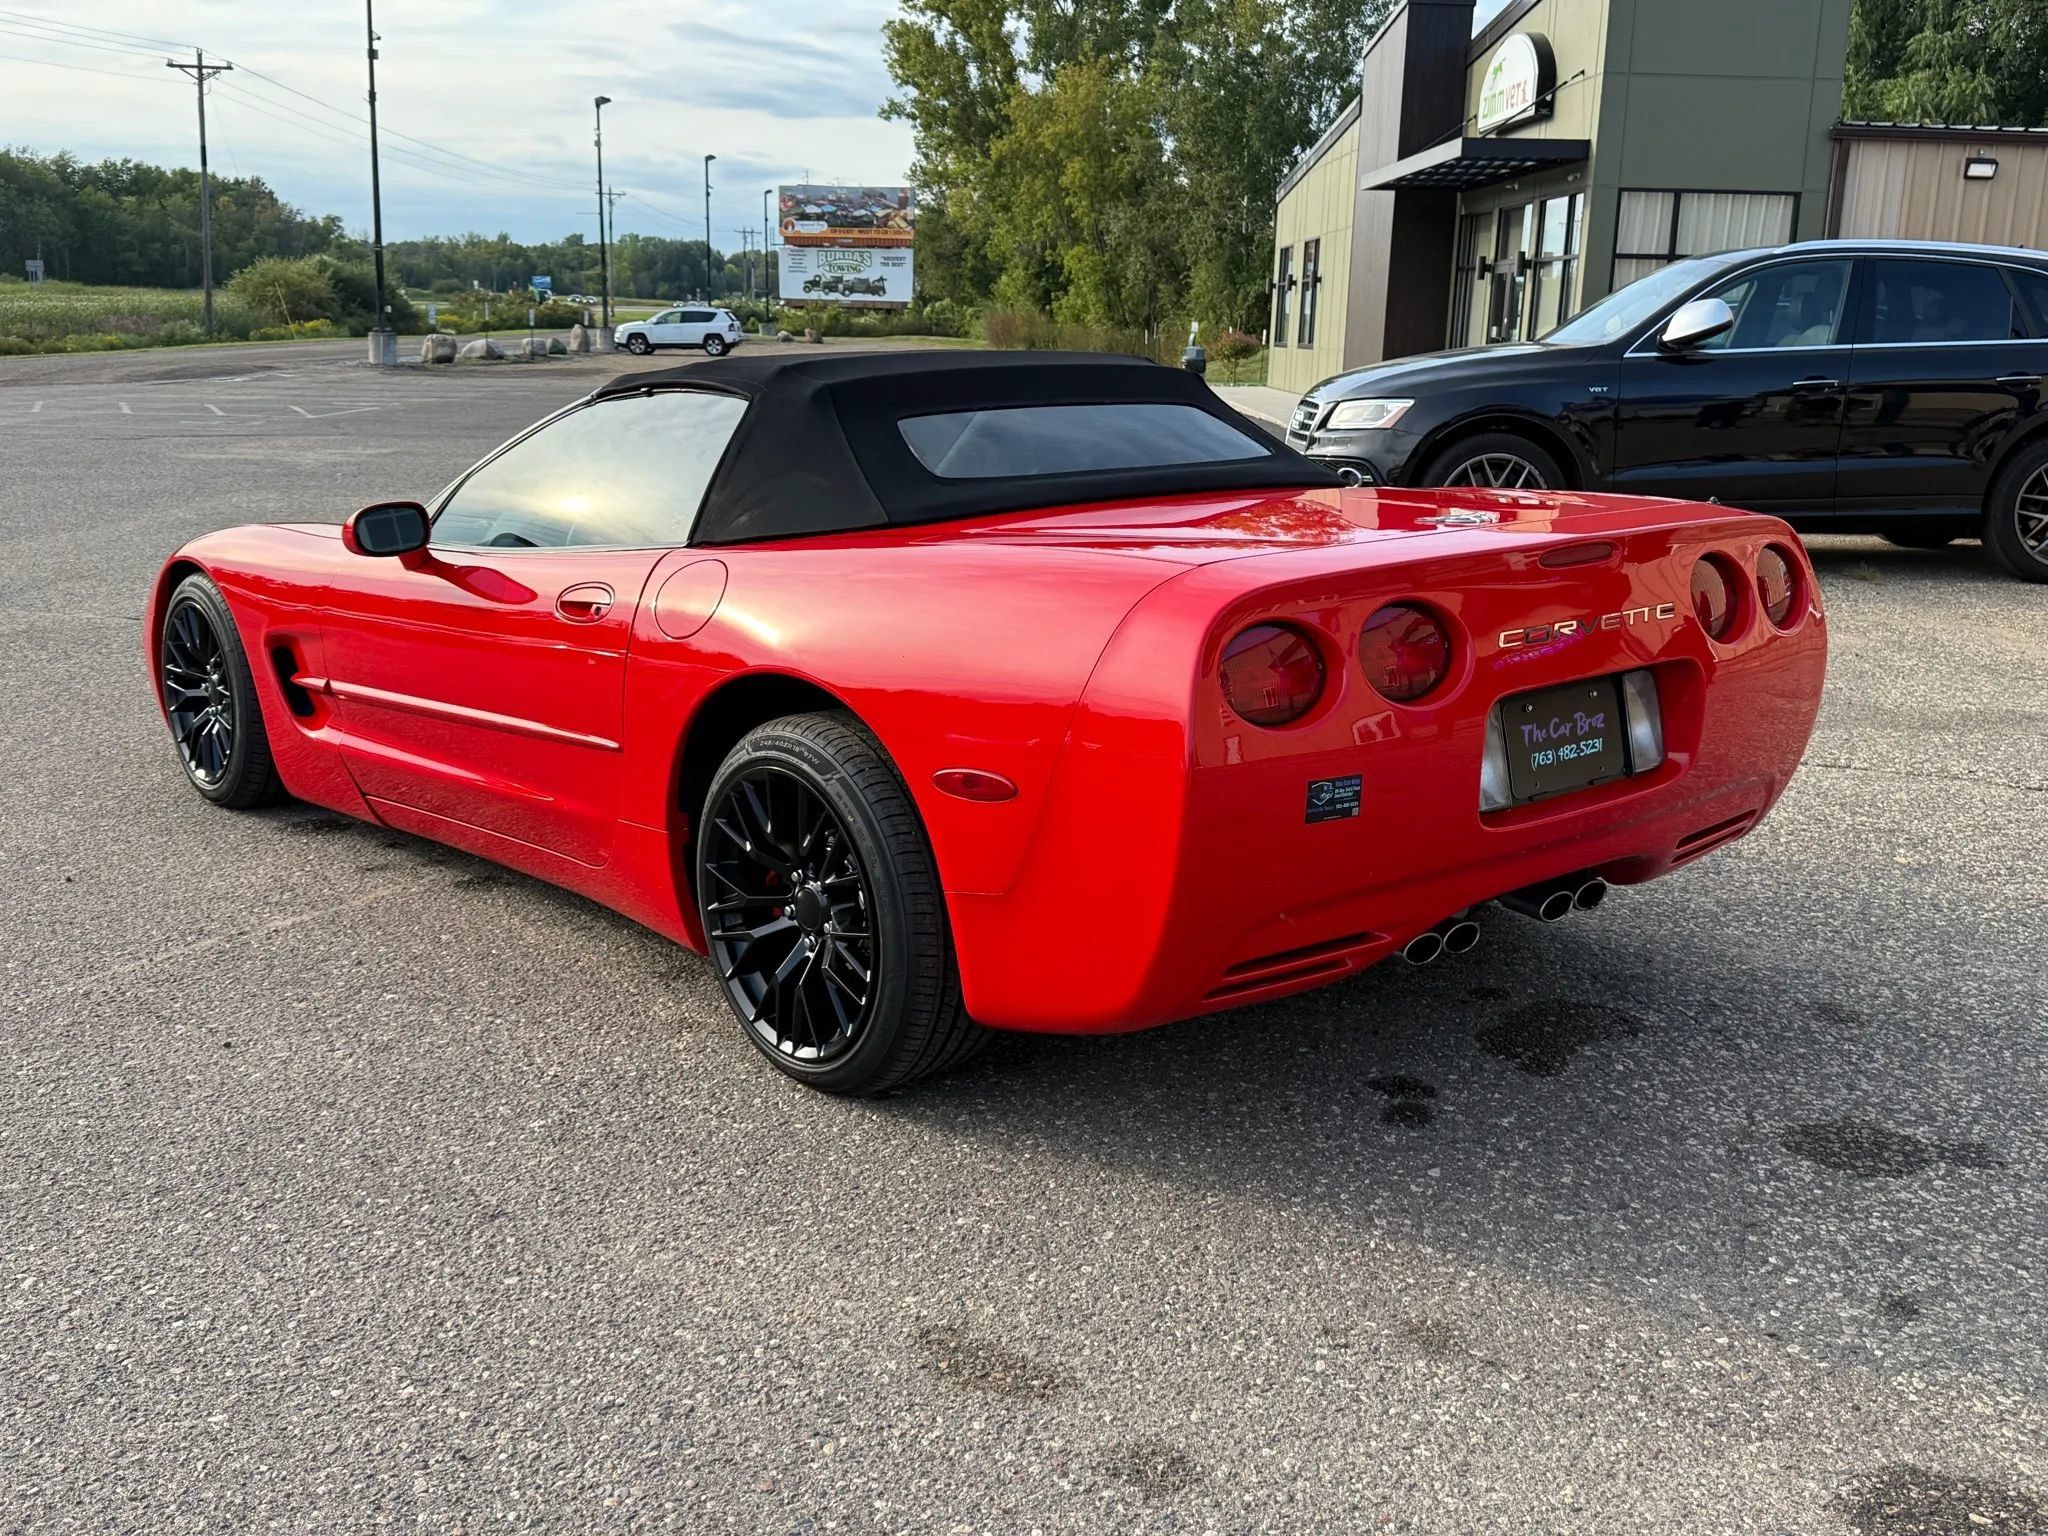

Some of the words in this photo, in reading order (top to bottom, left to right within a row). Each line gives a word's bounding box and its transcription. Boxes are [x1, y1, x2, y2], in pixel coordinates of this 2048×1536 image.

[817, 250, 872, 269] BURDA'S
[827, 263, 862, 273] TOWING
[1498, 602, 1675, 648] CORVETTE
[1521, 723, 1547, 747] The
[1549, 716, 1573, 739] Car
[803, 751, 820, 765] 97W
[1530, 749, 1557, 771] (763)
[1558, 738, 1603, 760] 482-5231
